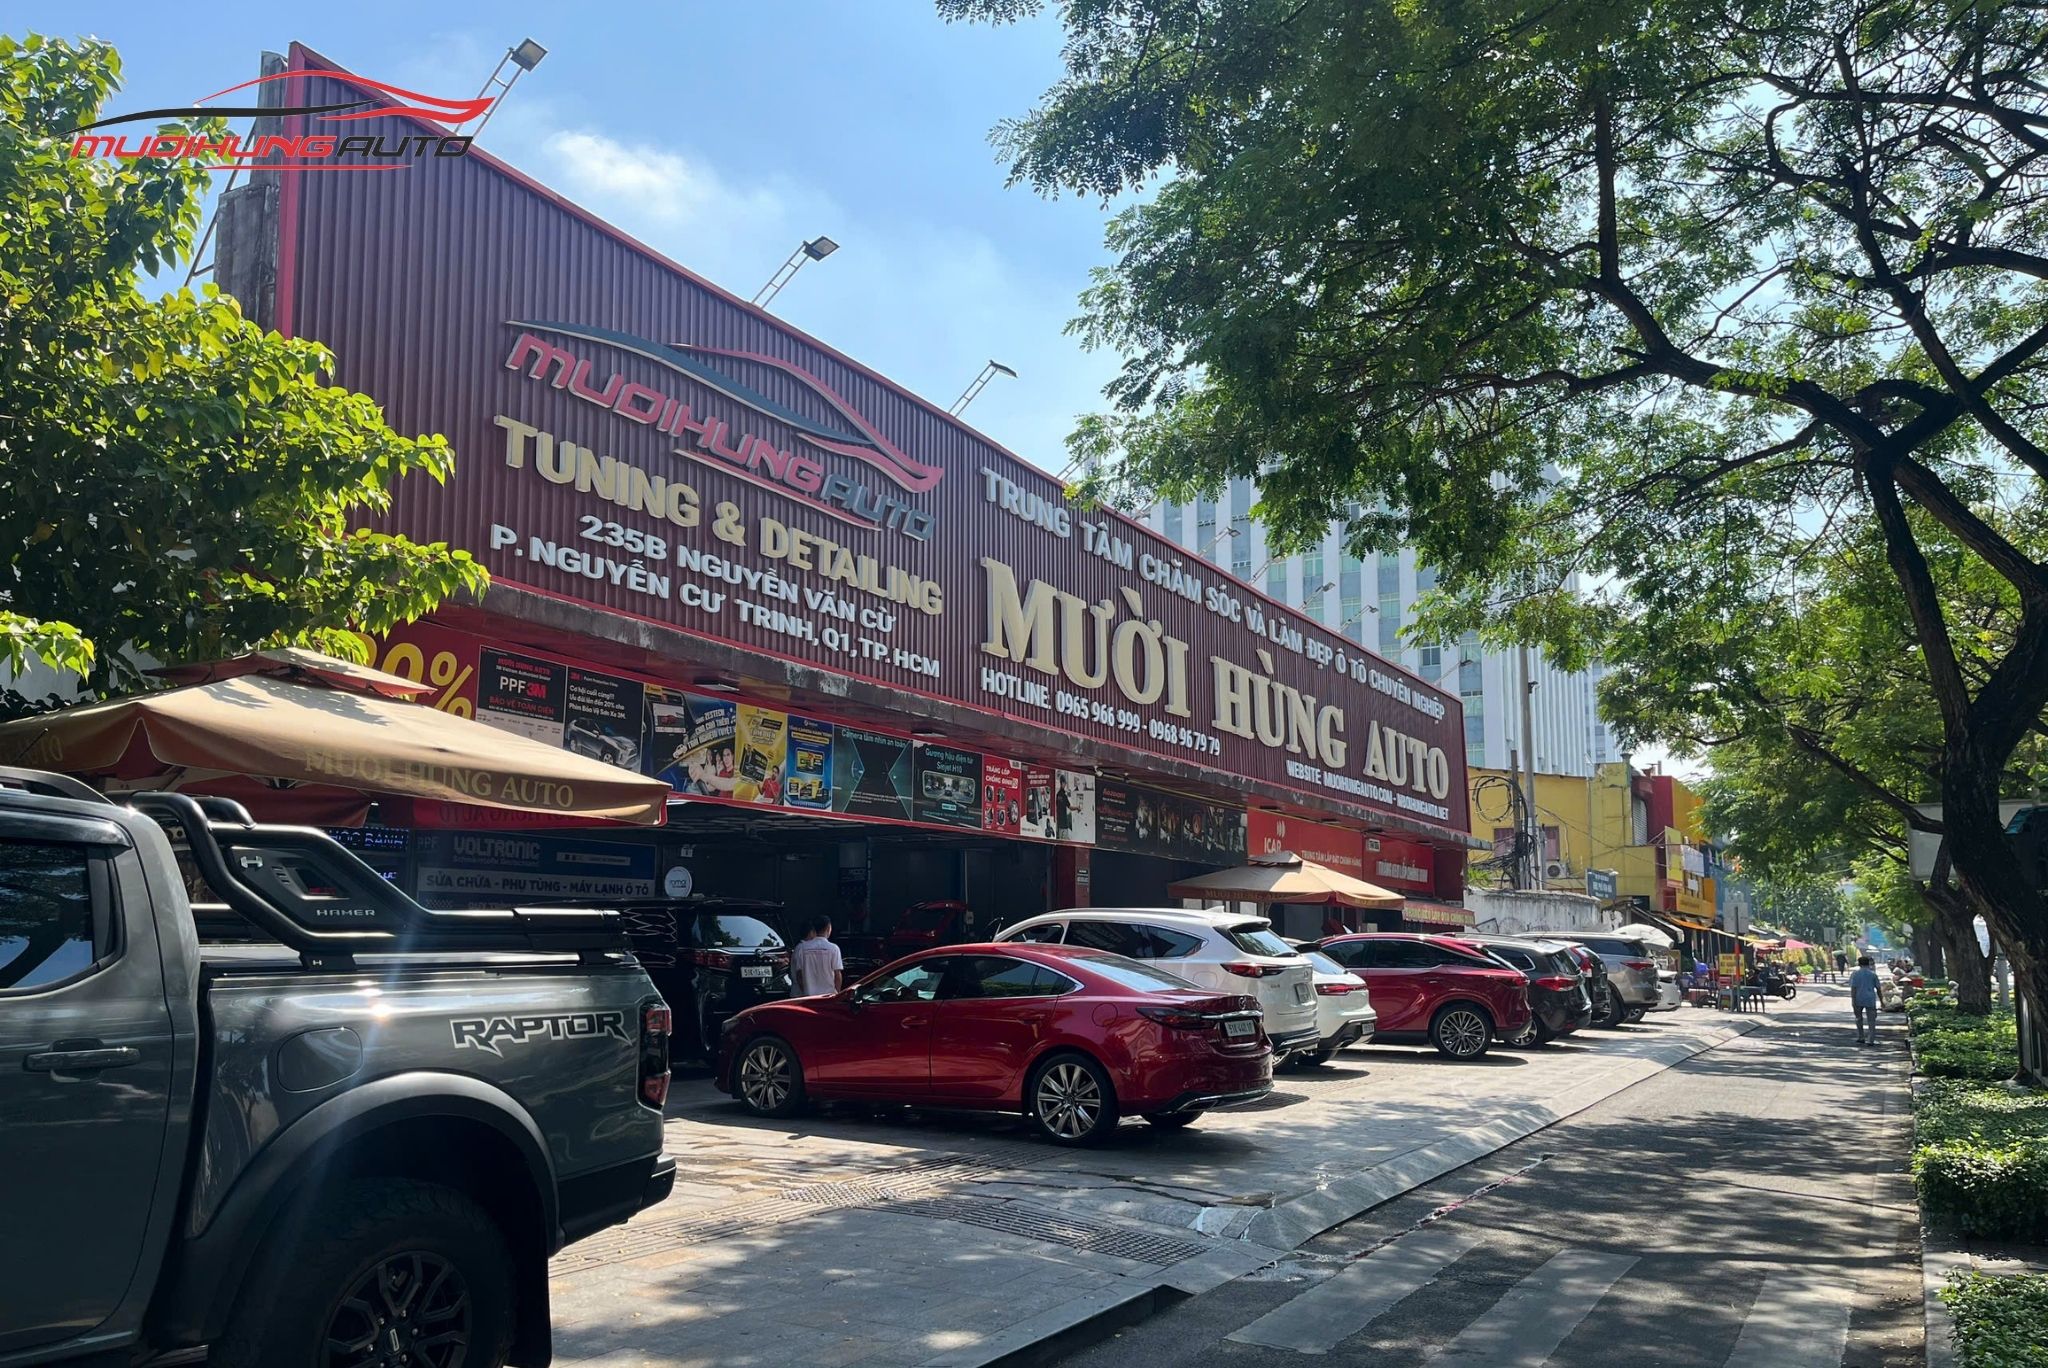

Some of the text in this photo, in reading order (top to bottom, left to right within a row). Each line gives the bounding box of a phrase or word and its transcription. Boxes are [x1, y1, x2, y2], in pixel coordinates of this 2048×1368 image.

[493, 415, 944, 616] TUNING & DETAILING
[490, 523, 523, 557] P.
[529, 536, 669, 599] NGUYỄN
[679, 583, 727, 613] CƯ
[579, 514, 896, 633] 235B NGUYỄN VĂN CỪ
[980, 466, 1445, 725] TRUNG TÂM CHĂM SÓC VÀ LÀM ĐẸP Ô TÔ CHUYÊN NGHIỆP
[500, 676, 546, 698] PPF 3M
[981, 556, 1449, 800] MƯỜI HÙNG AUTO
[841, 729, 862, 740] Camera
[1055, 690, 1089, 720] 0965
[1091, 701, 1115, 726] 966
[1117, 709, 1141, 733] 999
[1149, 718, 1178, 745] 0968
[502, 777, 574, 808] AUTO
[454, 835, 541, 861] VOLTRONIC
[529, 875, 560, 892] TÙNG
[569, 879, 593, 893] MÁY
[449, 1011, 633, 1058] RAPTOR
